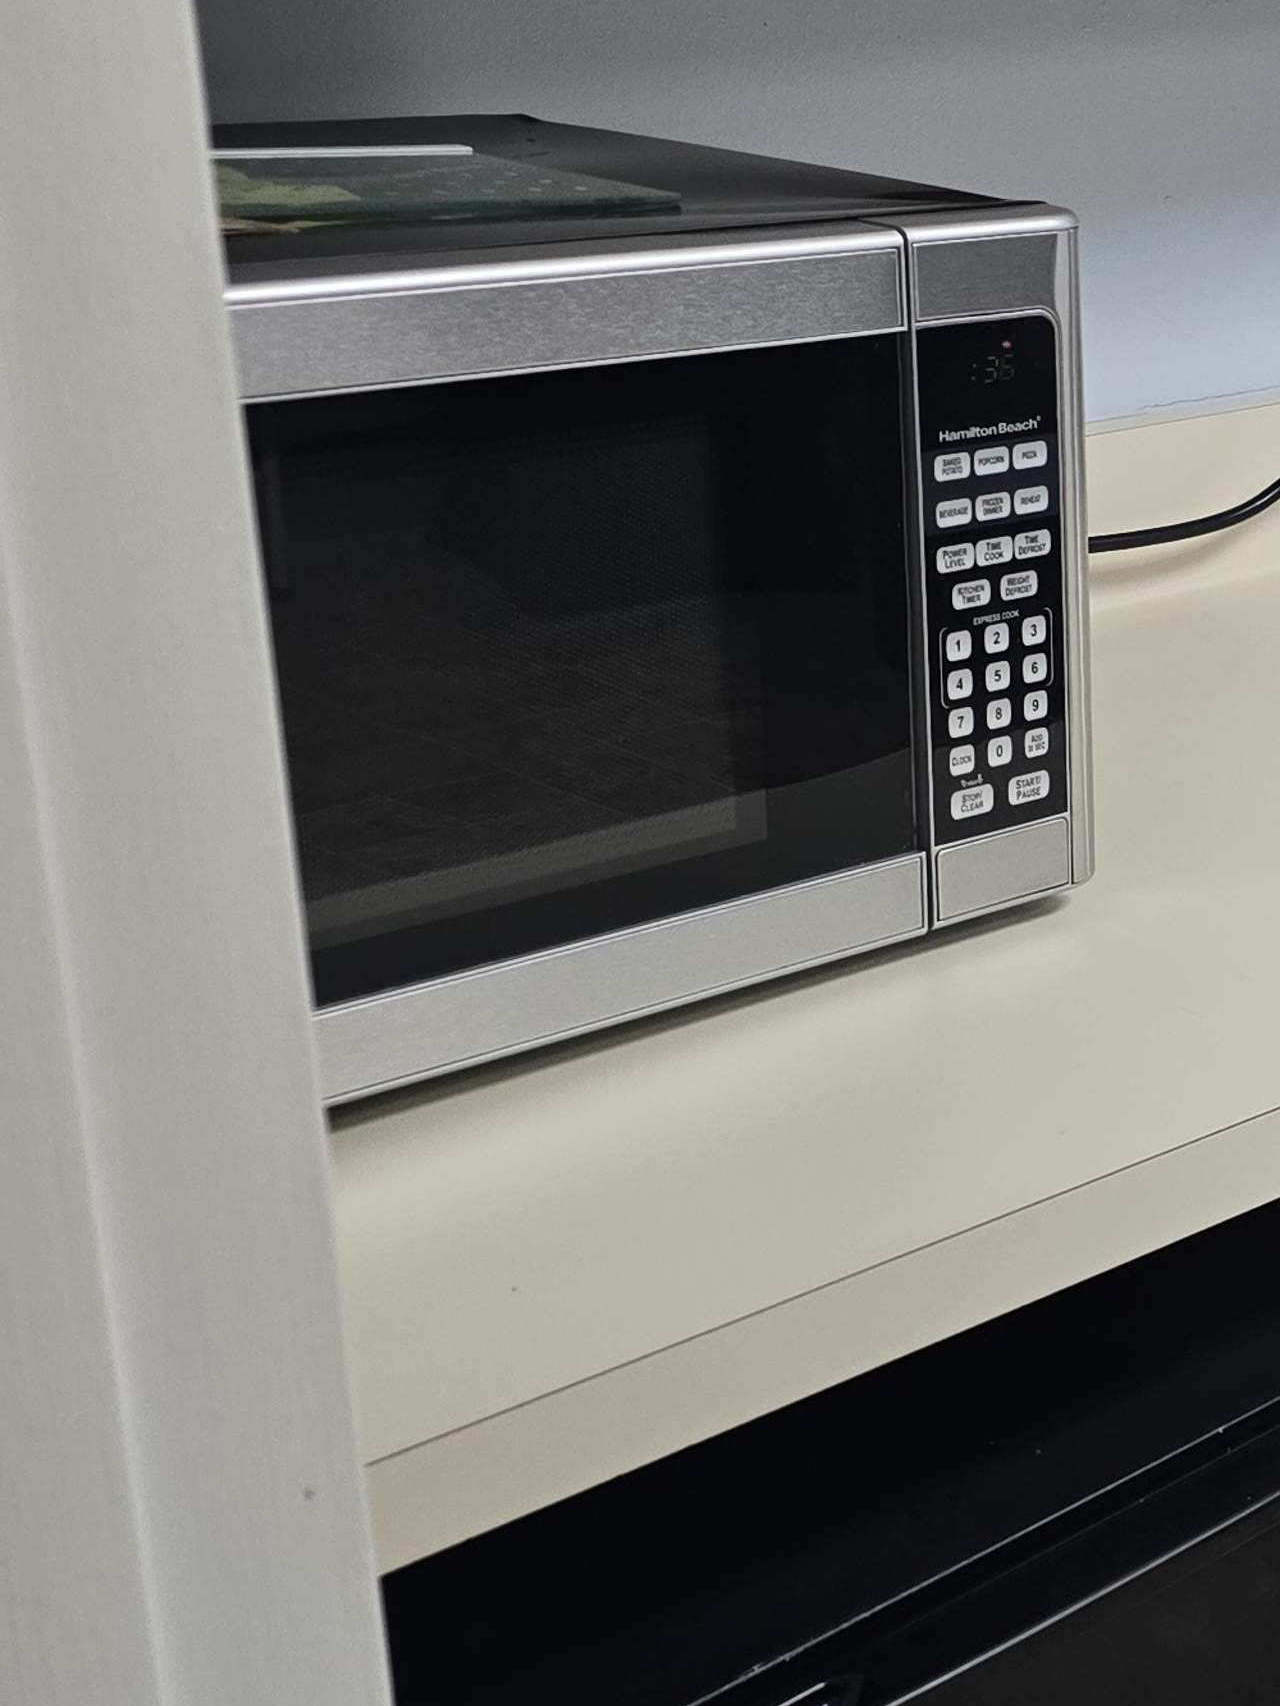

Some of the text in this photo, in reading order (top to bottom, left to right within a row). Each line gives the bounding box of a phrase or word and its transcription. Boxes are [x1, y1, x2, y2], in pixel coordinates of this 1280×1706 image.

[939, 426, 997, 443] Hamilton
[978, 456, 1004, 466] POPCORN
[982, 497, 1003, 507] FROZEN
[939, 507, 968, 519] BEVERAGE
[973, 609, 1020, 626] EXPRESS COOK
[1030, 624, 1038, 637] 3
[993, 632, 1001, 645] 2
[955, 639, 961, 652] 1
[1032, 662, 1038, 674] 6
[994, 670, 1001, 682] 5
[956, 678, 963, 690] 4
[1032, 699, 1039, 712] 9
[995, 707, 1002, 720] 8
[958, 716, 964, 729] 7
[996, 745, 1003, 757] 0
[1016, 787, 1041, 801] PAUSE
[961, 801, 983, 813] CLEAR
